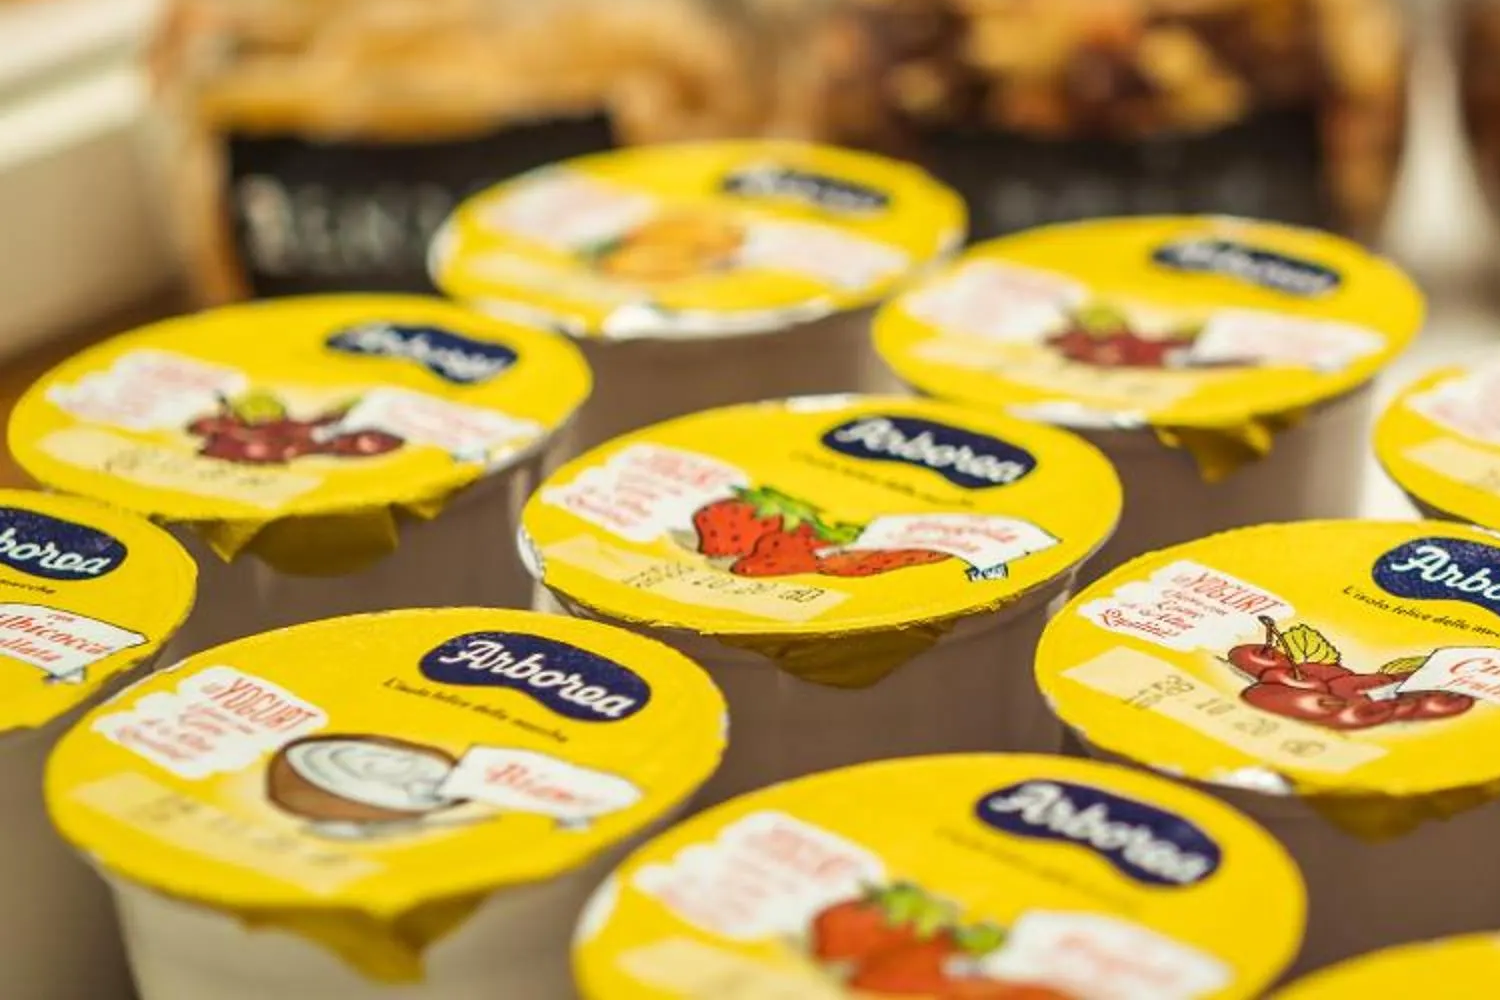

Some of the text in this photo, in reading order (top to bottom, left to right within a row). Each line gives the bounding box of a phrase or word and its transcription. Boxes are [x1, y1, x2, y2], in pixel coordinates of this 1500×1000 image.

[834, 417, 1027, 483] Arborea
[439, 639, 637, 717] Arborea
[987, 782, 1210, 884] Arborea
